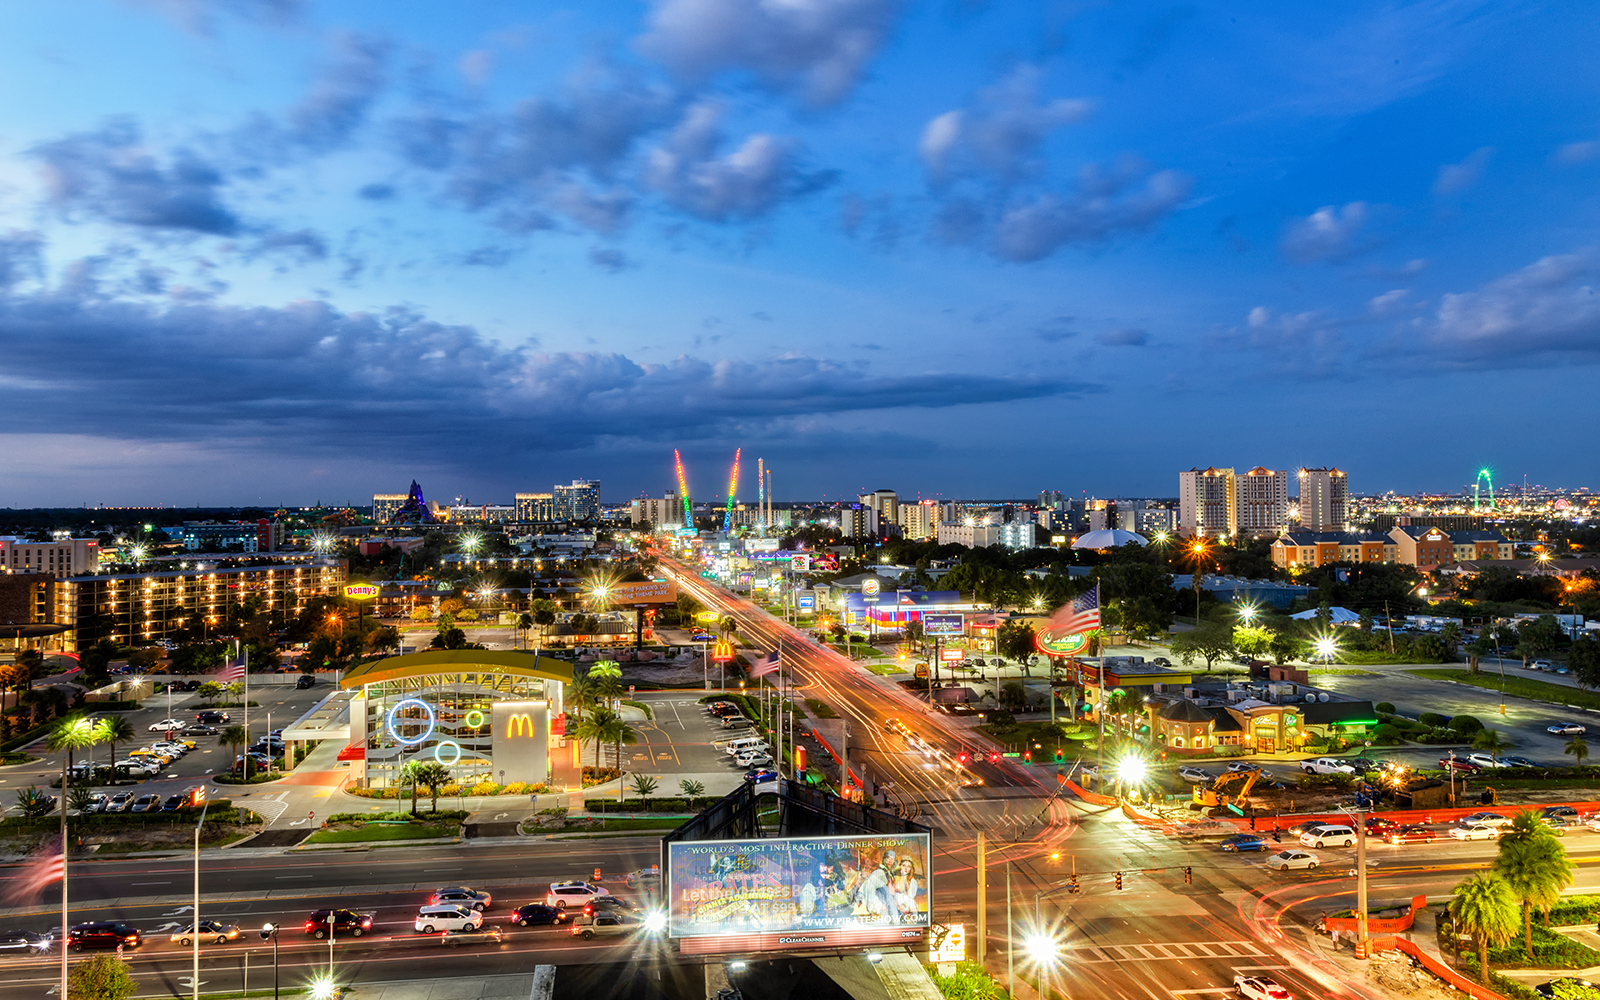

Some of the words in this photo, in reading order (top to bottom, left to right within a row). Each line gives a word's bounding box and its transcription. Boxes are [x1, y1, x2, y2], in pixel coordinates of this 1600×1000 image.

[347, 586, 377, 595] Denny's
[739, 844, 766, 852] MOST
[770, 842, 833, 852] INTERACTIVE
[837, 840, 873, 849] DINNER
[698, 897, 727, 913] DINNER
[772, 901, 815, 914] $99.99
[804, 914, 927, 927] WWW.PIRATESHOW.COM
